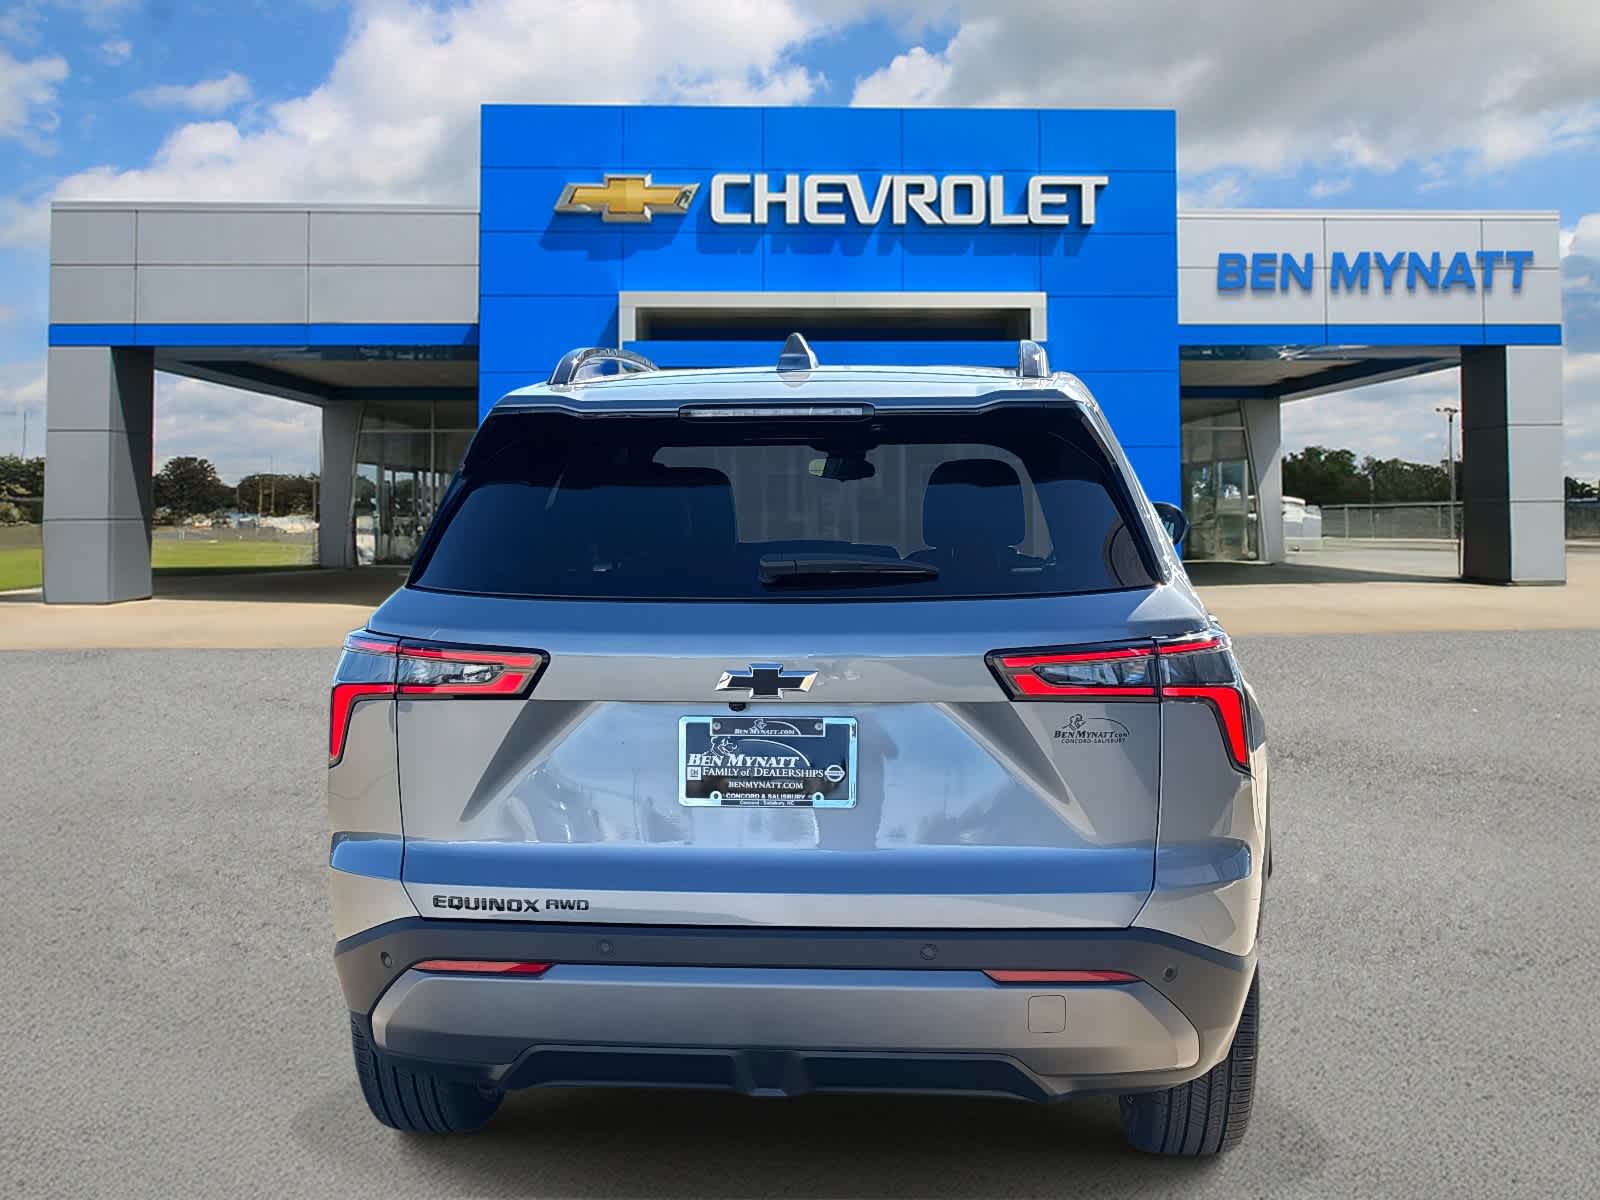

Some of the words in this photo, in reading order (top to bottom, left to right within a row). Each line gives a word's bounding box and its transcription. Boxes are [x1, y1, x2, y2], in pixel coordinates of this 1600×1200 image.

[710, 173, 1109, 226] CHEVROLET
[1217, 252, 1314, 291] BEN
[1330, 250, 1534, 291] MYNATT
[688, 753, 722, 767] BEN
[727, 754, 800, 767] MYNATT
[702, 767, 738, 776] FAMILY
[740, 768, 751, 777] of
[754, 767, 824, 778] DEALERSHIPS
[728, 781, 804, 789] BENMYNATT.COM
[432, 894, 540, 912] EQUINOX
[545, 899, 590, 911] AWD
